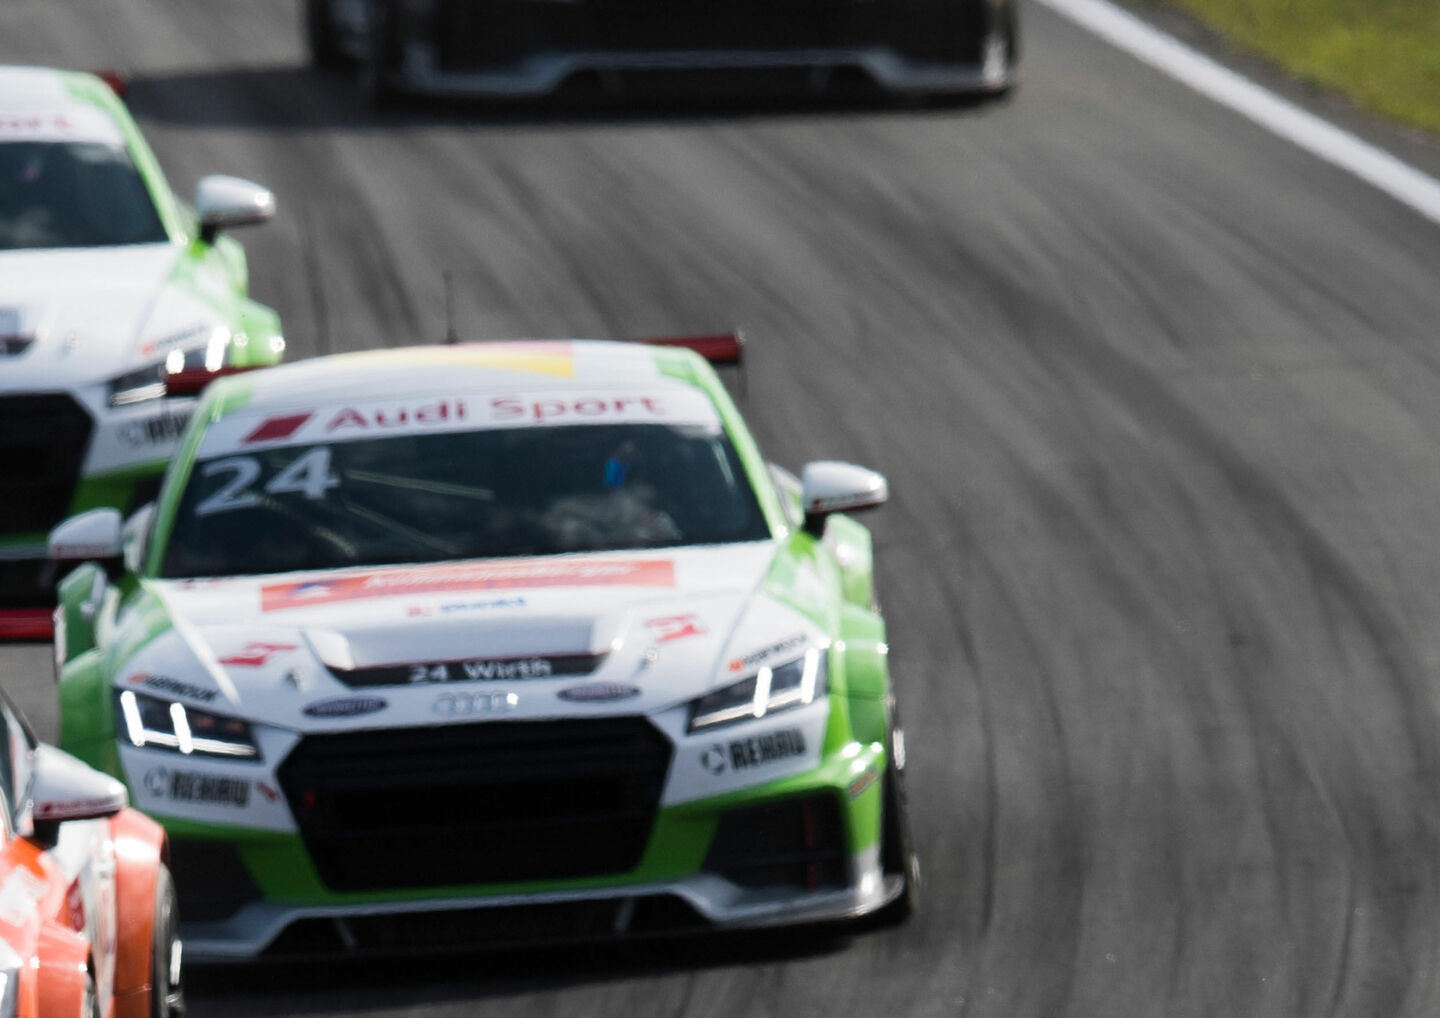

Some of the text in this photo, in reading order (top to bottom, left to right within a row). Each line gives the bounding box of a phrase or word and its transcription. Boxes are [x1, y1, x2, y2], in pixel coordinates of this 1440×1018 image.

[325, 395, 671, 432] Audi Sport
[195, 447, 340, 517] 24
[409, 659, 552, 682] 24 Wirth
